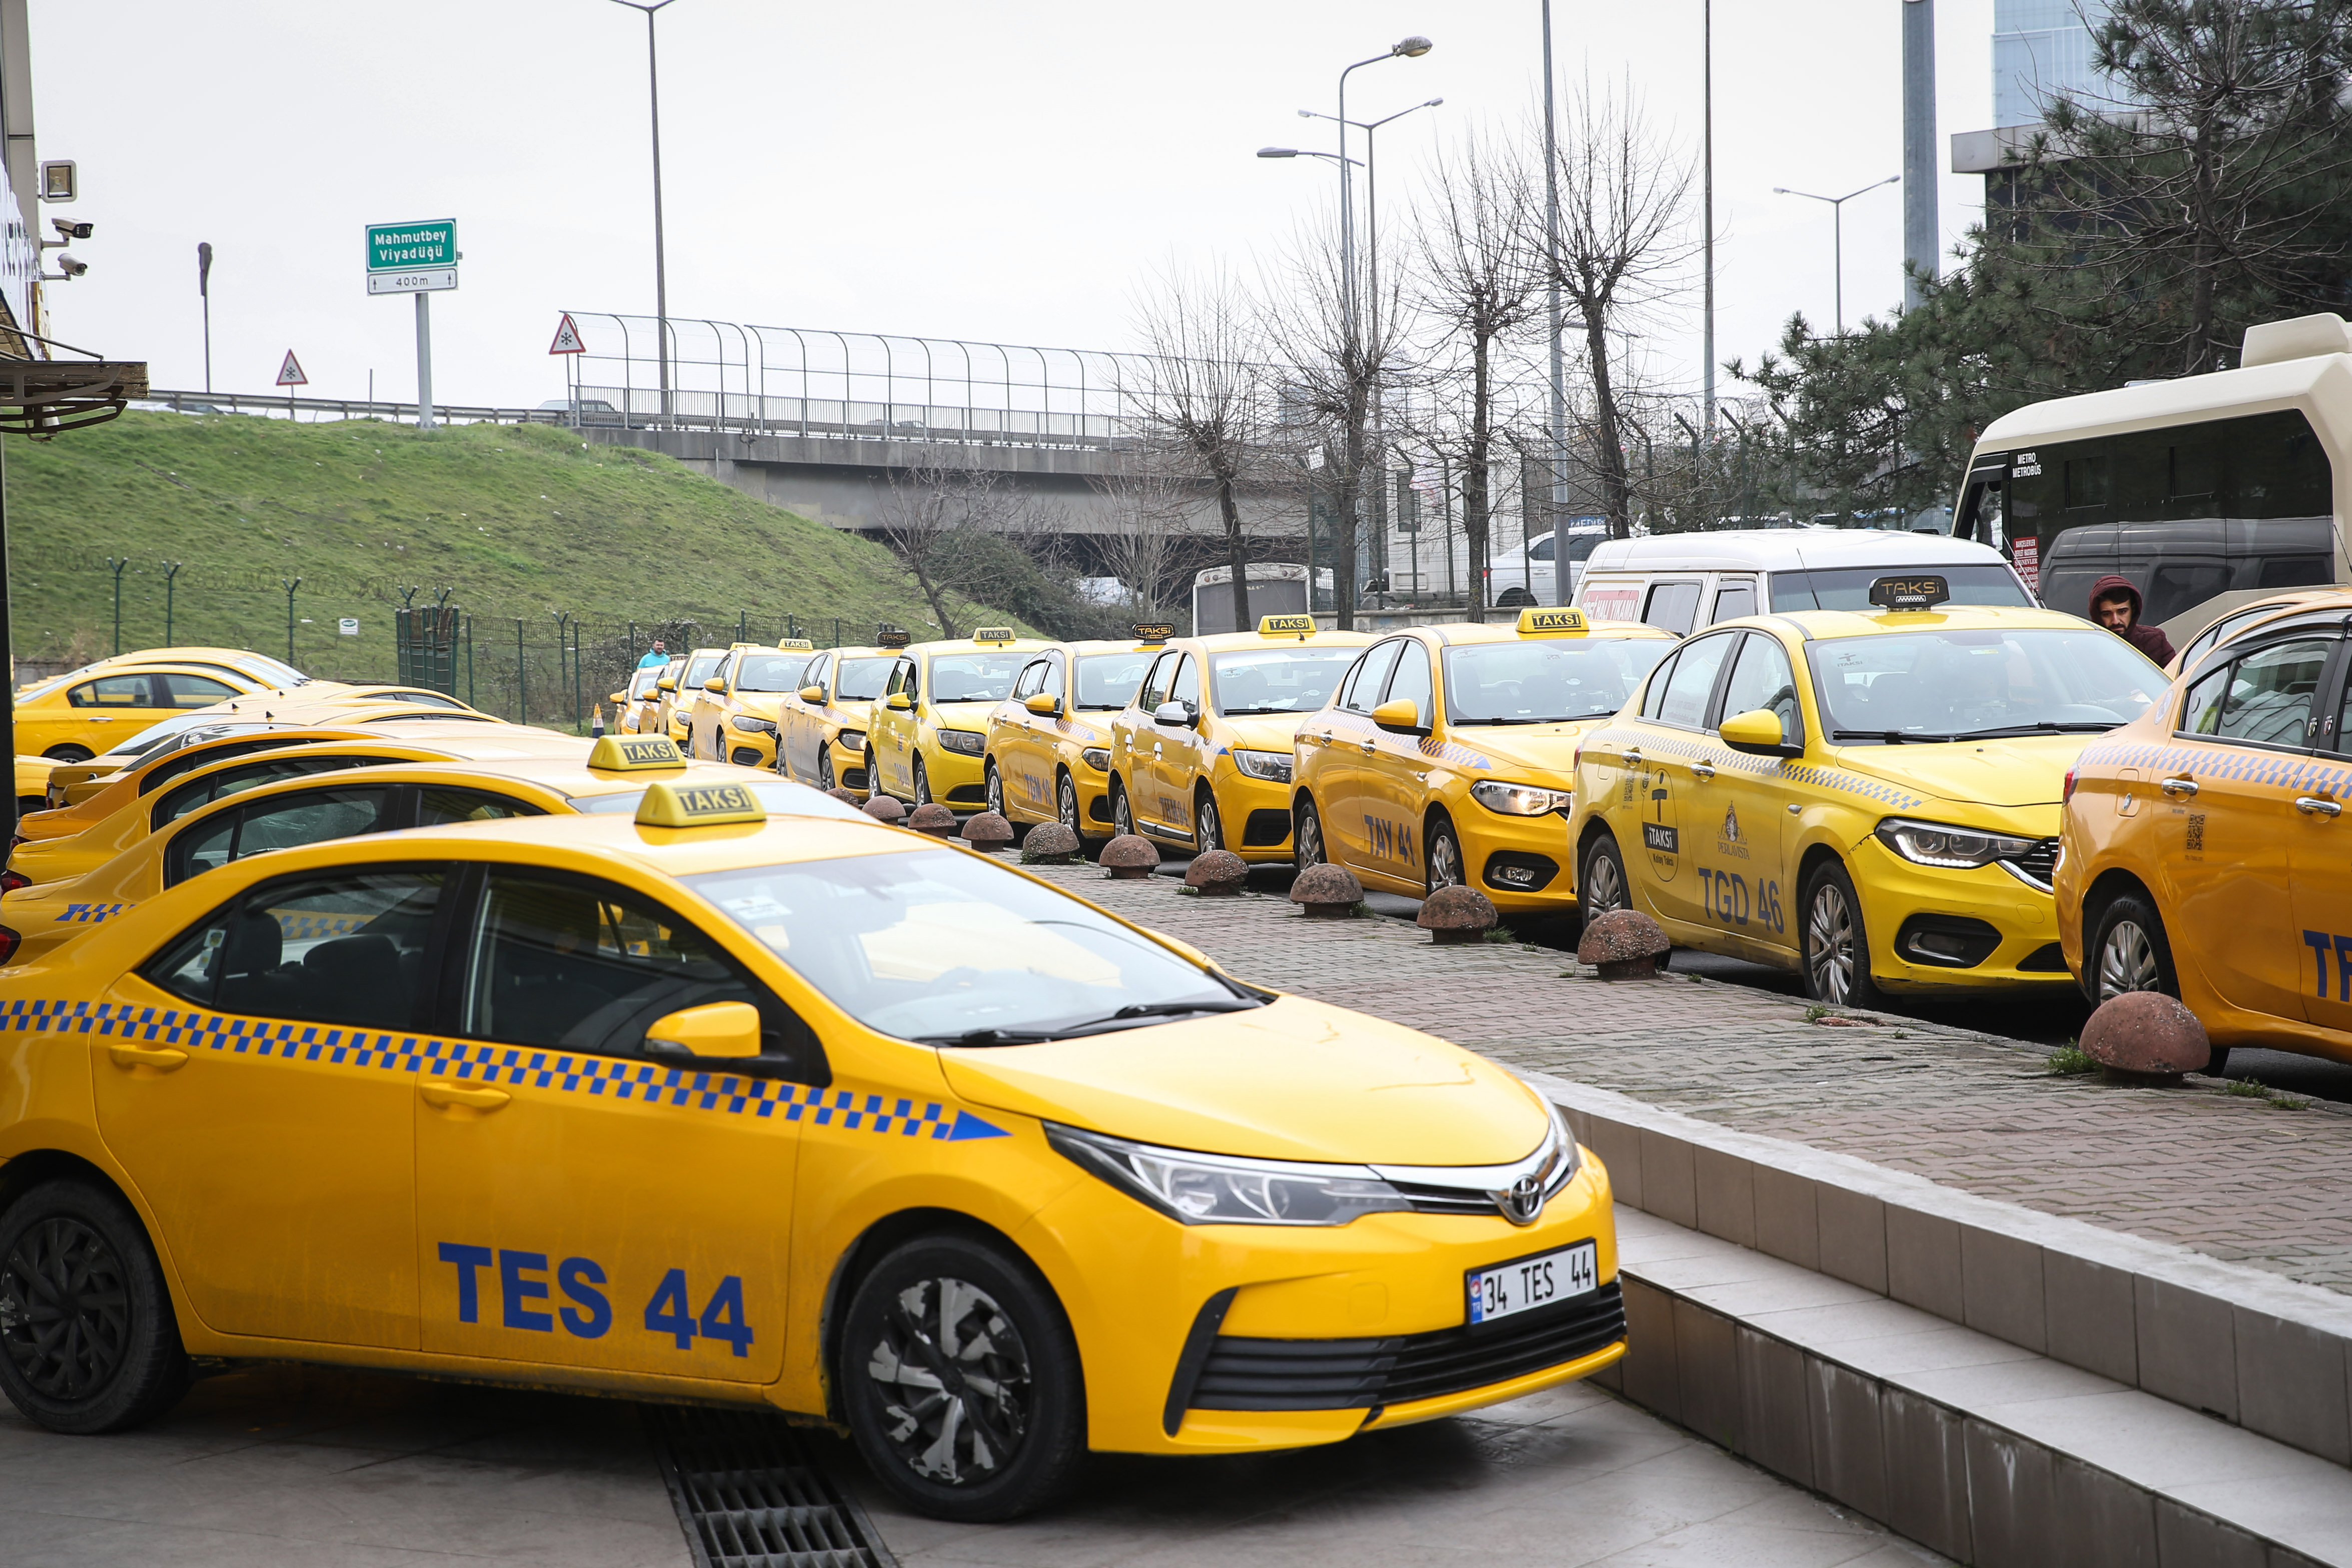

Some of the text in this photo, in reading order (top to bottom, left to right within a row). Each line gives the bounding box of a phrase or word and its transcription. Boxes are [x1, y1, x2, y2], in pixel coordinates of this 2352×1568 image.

[375, 230, 447, 246] Mahmutbey
[380, 245, 443, 263] Viyadüğü
[396, 277, 429, 287] 400m
[2017, 452, 2036, 465] METRO
[2012, 462, 2041, 478] METROBÜS
[1881, 581, 1939, 595] TAKSi
[1270, 619, 1309, 629] TAKSi
[1533, 614, 1580, 626] TAKSi
[623, 743, 676, 760] TAKSi
[677, 788, 750, 811] TAKSi
[1364, 813, 1416, 867] TAY 41
[1717, 841, 1750, 860] PERLAVISTA
[1698, 867, 1784, 934] TGD 46
[1484, 1250, 1591, 1314] 34 TES 44
[438, 1242, 754, 1358] TES 44
[1472, 1301, 1482, 1314] TR
